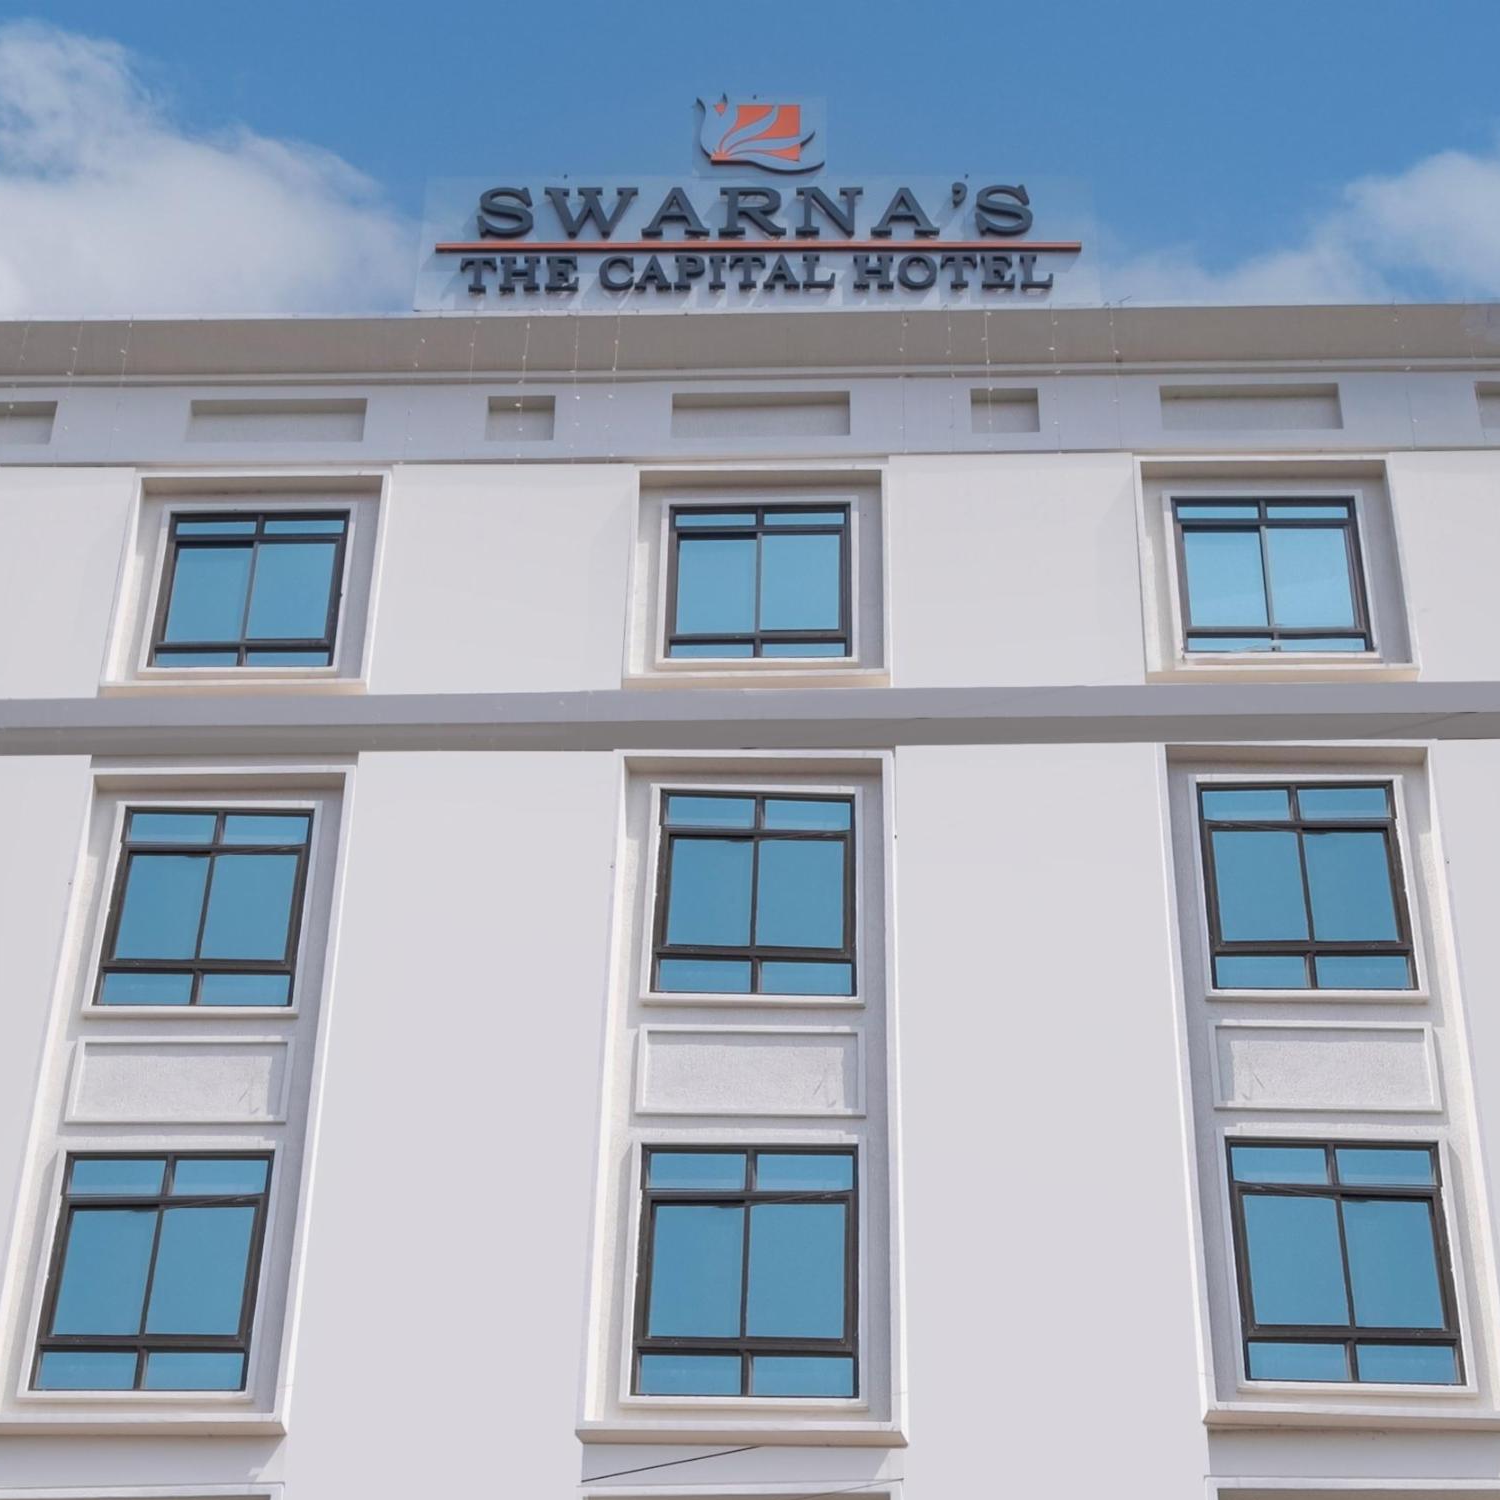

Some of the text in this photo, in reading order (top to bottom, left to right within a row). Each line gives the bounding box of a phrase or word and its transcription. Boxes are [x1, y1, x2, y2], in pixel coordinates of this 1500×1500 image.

[477, 182, 1034, 240] SWARNA'S
[460, 252, 1054, 294] THE CAPITAL HOTEL
